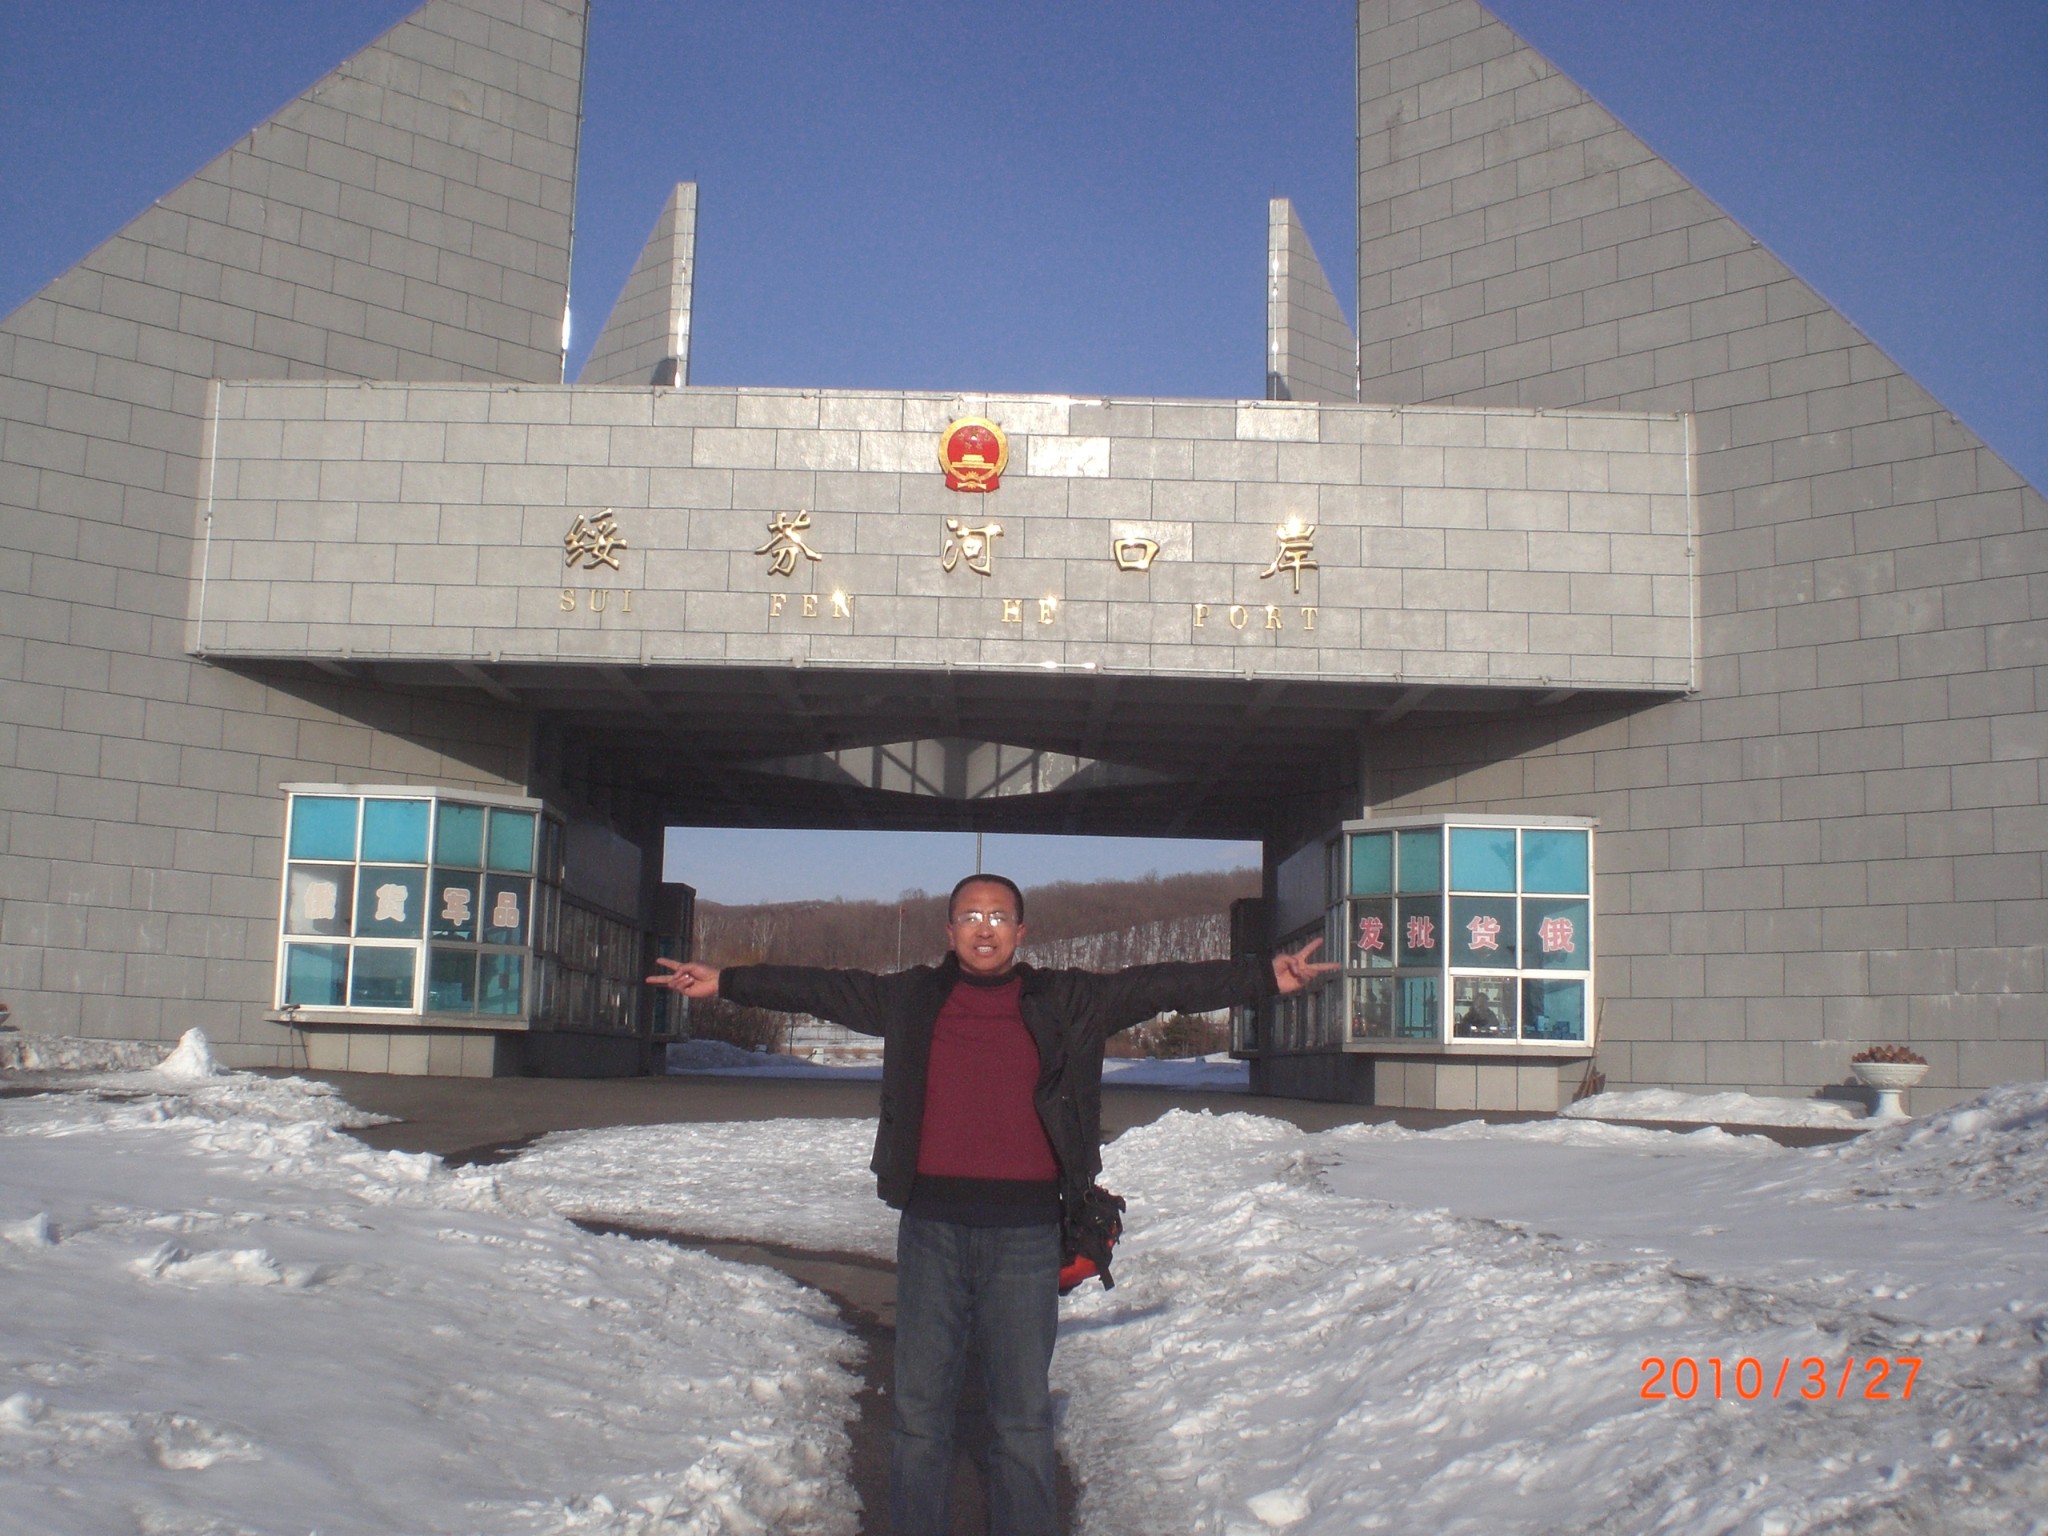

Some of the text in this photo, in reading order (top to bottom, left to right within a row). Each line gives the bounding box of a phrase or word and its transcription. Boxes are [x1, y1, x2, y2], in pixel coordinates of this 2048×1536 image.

[562, 508, 1319, 594] 绥芬河口岸
[560, 588, 1319, 631] SUI FEN HE PORT
